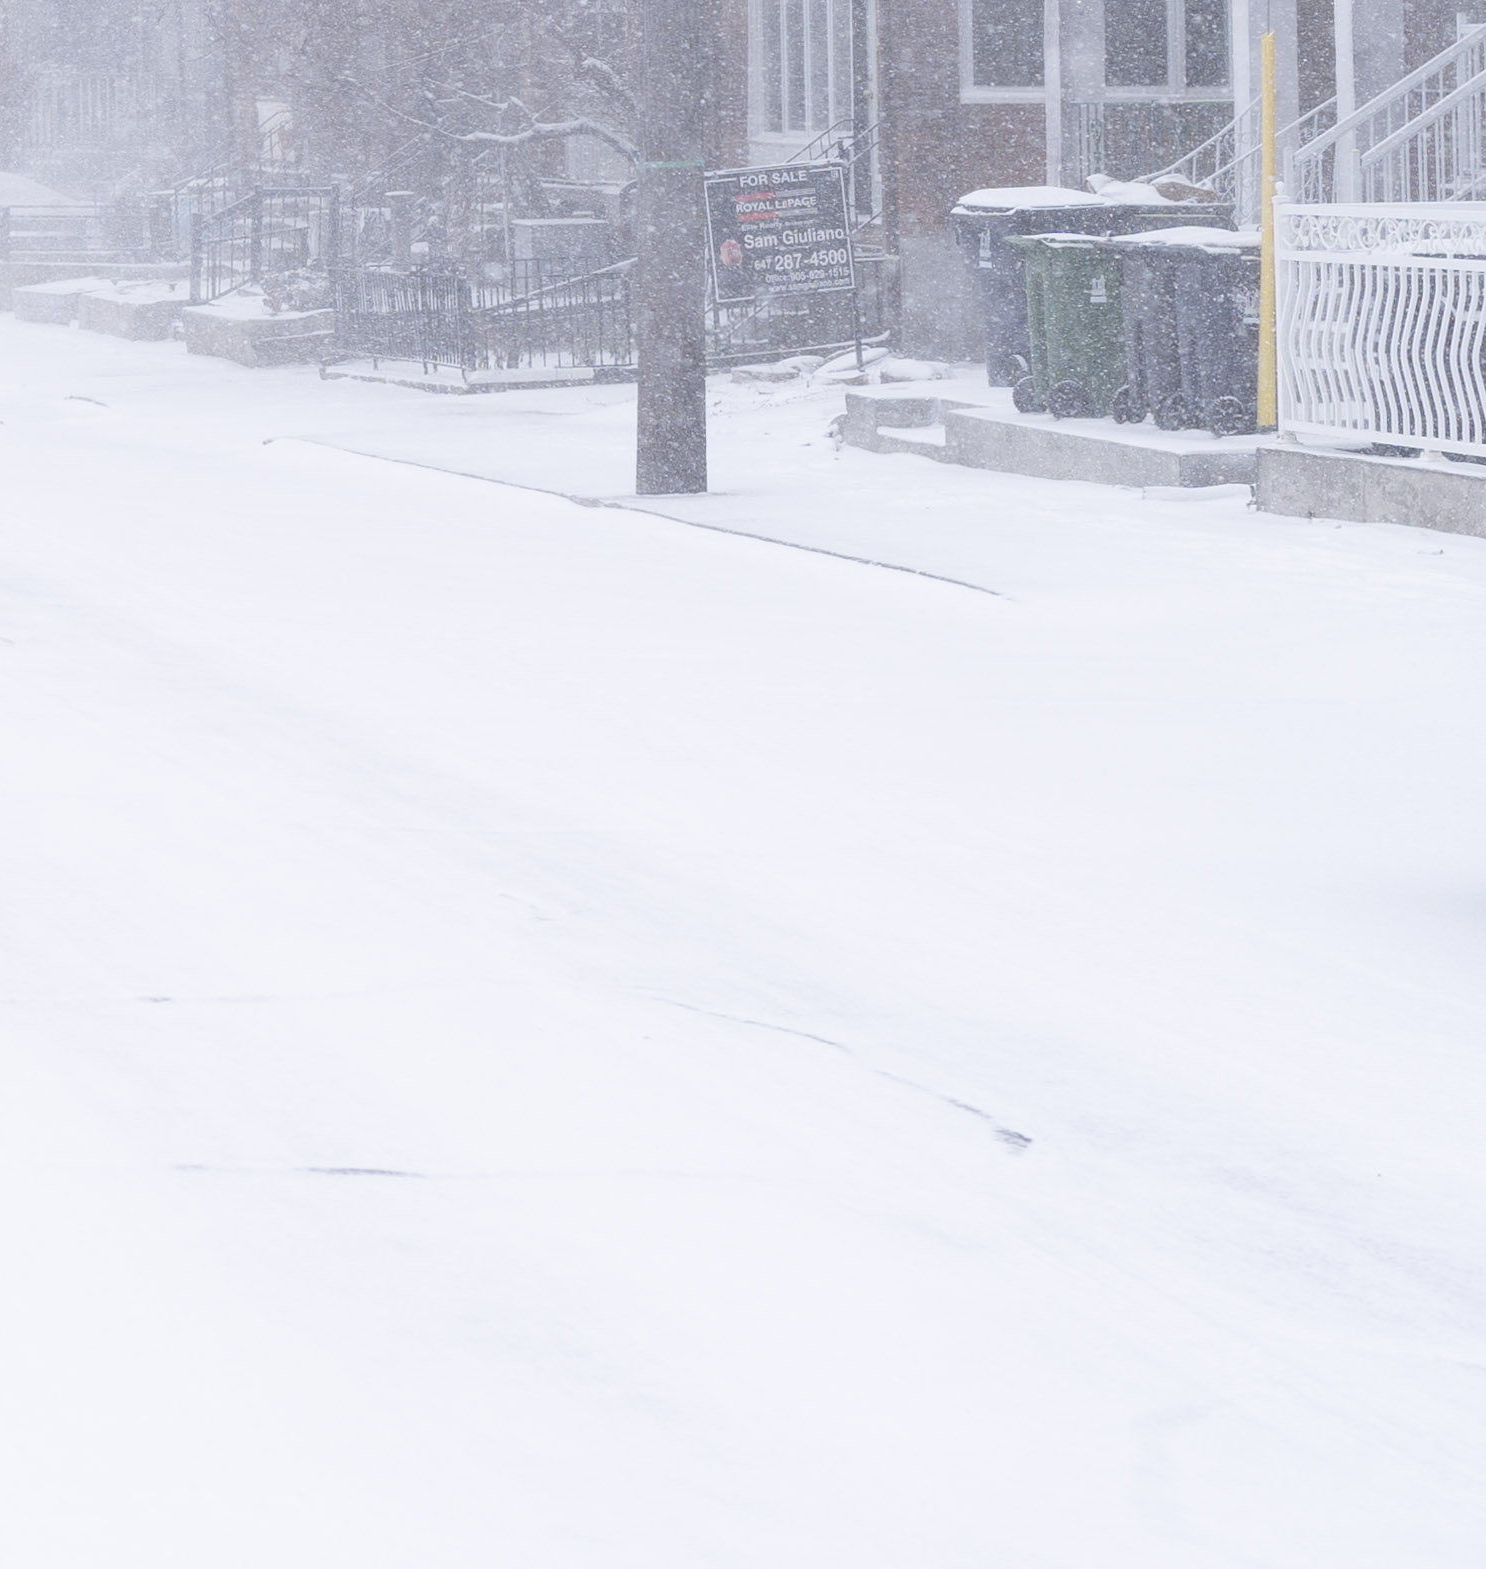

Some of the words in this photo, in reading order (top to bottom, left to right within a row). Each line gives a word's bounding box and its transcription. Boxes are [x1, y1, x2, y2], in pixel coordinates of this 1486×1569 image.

[739, 174, 768, 188] FOR
[771, 170, 807, 184] SALE
[735, 201, 774, 213] ROYAL
[744, 234, 778, 249] Sam
[782, 228, 844, 245] Giuliano
[774, 248, 847, 270] 287-4500
